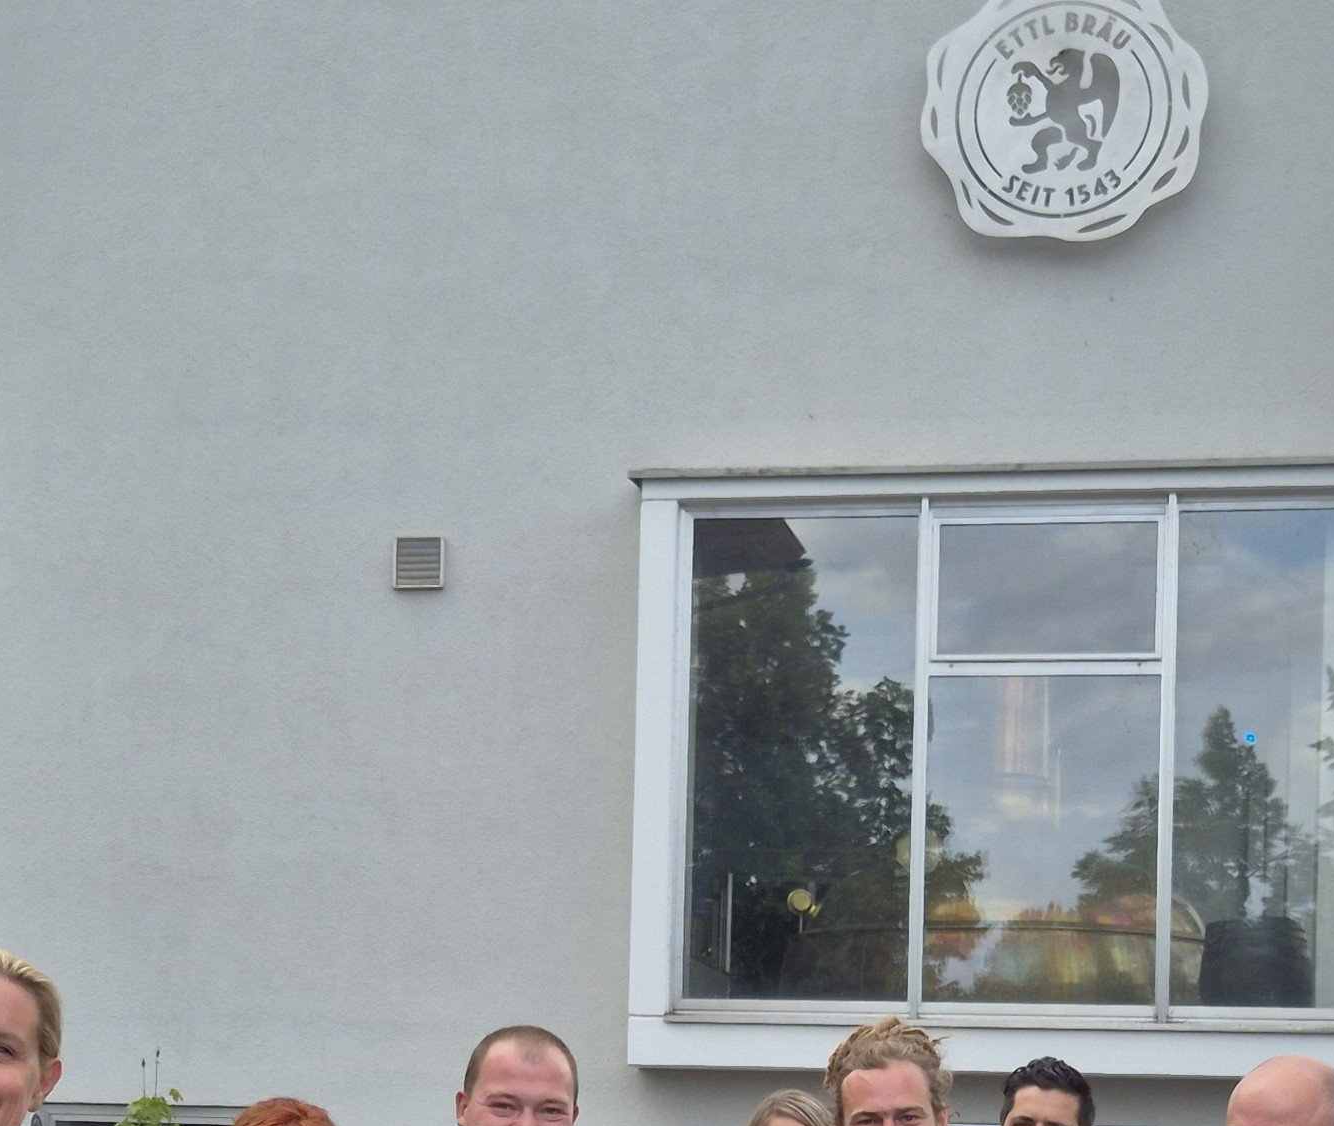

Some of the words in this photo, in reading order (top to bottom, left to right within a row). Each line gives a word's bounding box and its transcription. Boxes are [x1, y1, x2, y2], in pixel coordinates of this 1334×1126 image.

[994, 14, 1056, 61] ETTL
[1064, 11, 1132, 50] BRÄU
[1001, 174, 1056, 208] SEIT
[1064, 168, 1123, 207] 1543
